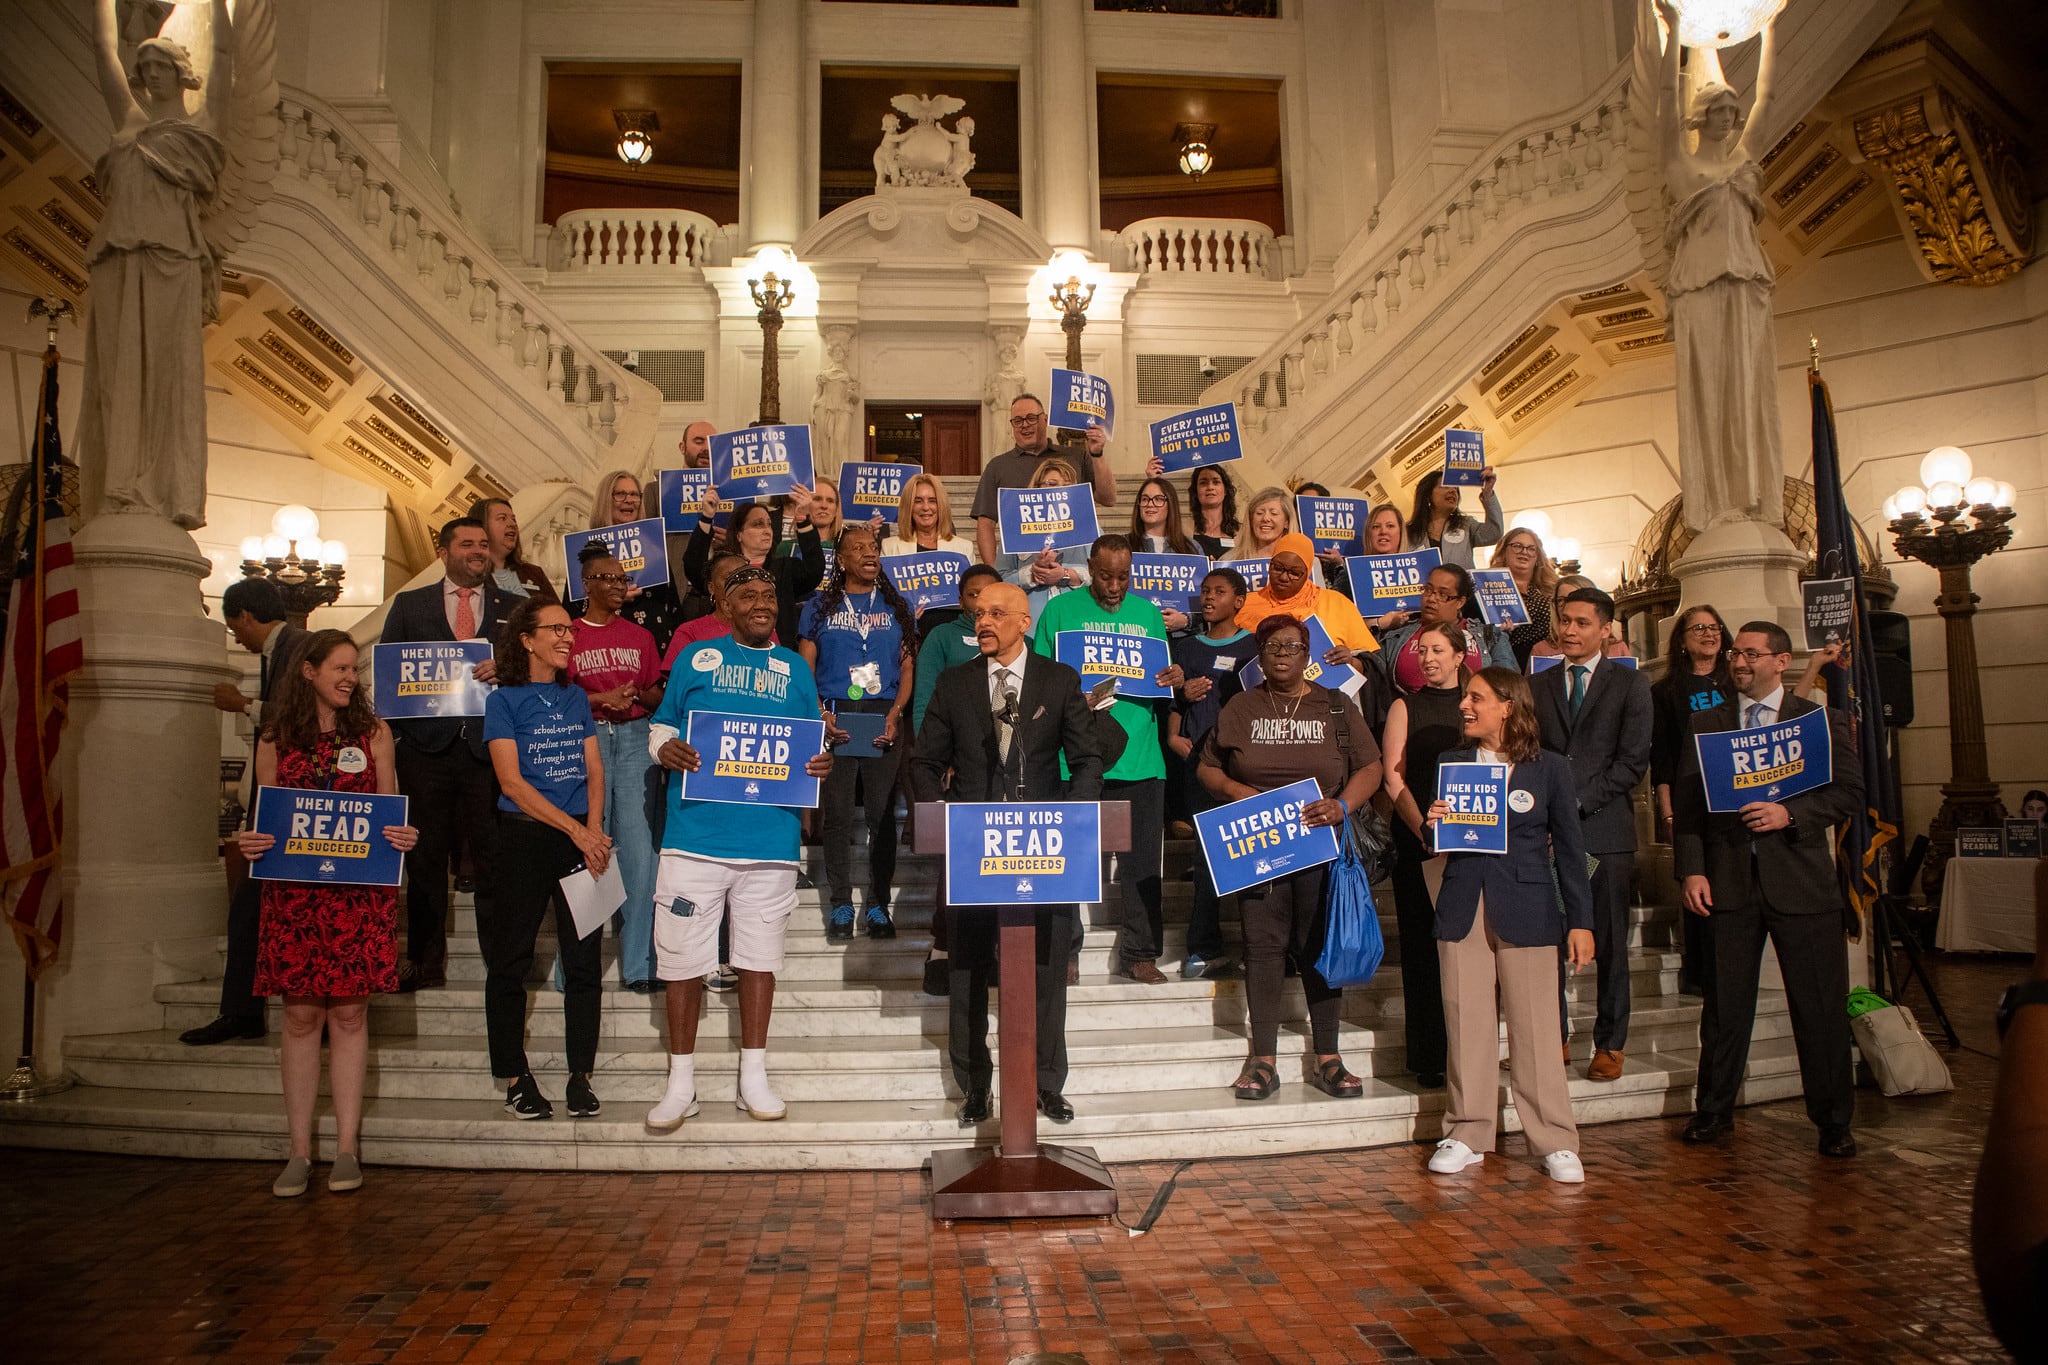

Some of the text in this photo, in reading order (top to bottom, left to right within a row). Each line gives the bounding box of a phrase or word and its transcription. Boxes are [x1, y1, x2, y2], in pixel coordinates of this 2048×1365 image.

[1072, 375, 1106, 392] WHEN KIDS
[1071, 385, 1106, 408] READ
[1161, 412, 1227, 435] EVERY CHILD
[733, 431, 785, 446] WHEN KIDS
[1160, 430, 1194, 443] DESERVES
[1208, 423, 1230, 433] LEARN
[1161, 432, 1231, 454] HOW TO READ
[732, 443, 787, 466] READ
[1451, 449, 1480, 462] READ
[733, 464, 787, 475] PA SUCCEEDS
[858, 467, 901, 476] WHEN KIDS
[683, 474, 707, 482] WHEN
[856, 477, 900, 495] READ
[682, 485, 705, 502] RE
[865, 496, 898, 504] SUCCEEDS
[1019, 492, 1068, 502] WHEN KIDS
[1020, 503, 1070, 522] READ
[1315, 502, 1354, 511] WHEN KIDS
[1034, 522, 1071, 530] SUCCEEDS
[1315, 512, 1354, 529] READ
[618, 527, 640, 539] KIDS
[624, 560, 642, 568] EEDS
[893, 561, 959, 578] LITERACY
[1237, 563, 1262, 573] WHEN
[1370, 557, 1417, 568] WHEN KIDS
[1131, 564, 1196, 578] LITERACY
[1371, 568, 1419, 587] READ
[898, 575, 940, 591] LIFTS
[1134, 578, 1195, 592] LIFTS PA
[1386, 587, 1421, 595] SUCCEEDS
[1816, 593, 1845, 604] PROUD
[1820, 601, 1850, 612] SUPPORT
[1085, 636, 1142, 649] WHEN KIDS
[402, 648, 464, 658] WHEN KIDS
[1084, 646, 1142, 667] READ
[1098, 665, 1142, 676] SUCCEEDS
[401, 682, 458, 692] PA SUCCEE
[1688, 690, 1724, 711] REA
[724, 721, 791, 737] WHEN KIDS
[1731, 725, 1801, 749] WHEN KIDS
[528, 738, 558, 753] pipeline
[719, 735, 789, 764] READ
[534, 752, 564, 764] through
[1732, 740, 1802, 775] READ
[718, 763, 786, 776] PA SUCCEEDS
[1736, 761, 1802, 785] PA SUCCEEDS
[1447, 784, 1497, 793] WHEN KIDS
[296, 797, 373, 813] WHEN KIDS
[1445, 794, 1497, 813] READ
[985, 811, 1063, 825] WHEN KIDS
[291, 813, 369, 841] READ
[289, 841, 366, 853] PA SUCCEEDS
[984, 829, 1063, 856] READ
[1227, 829, 1281, 859] LIFTS
[984, 860, 1061, 870] PA SUCCEEDS
